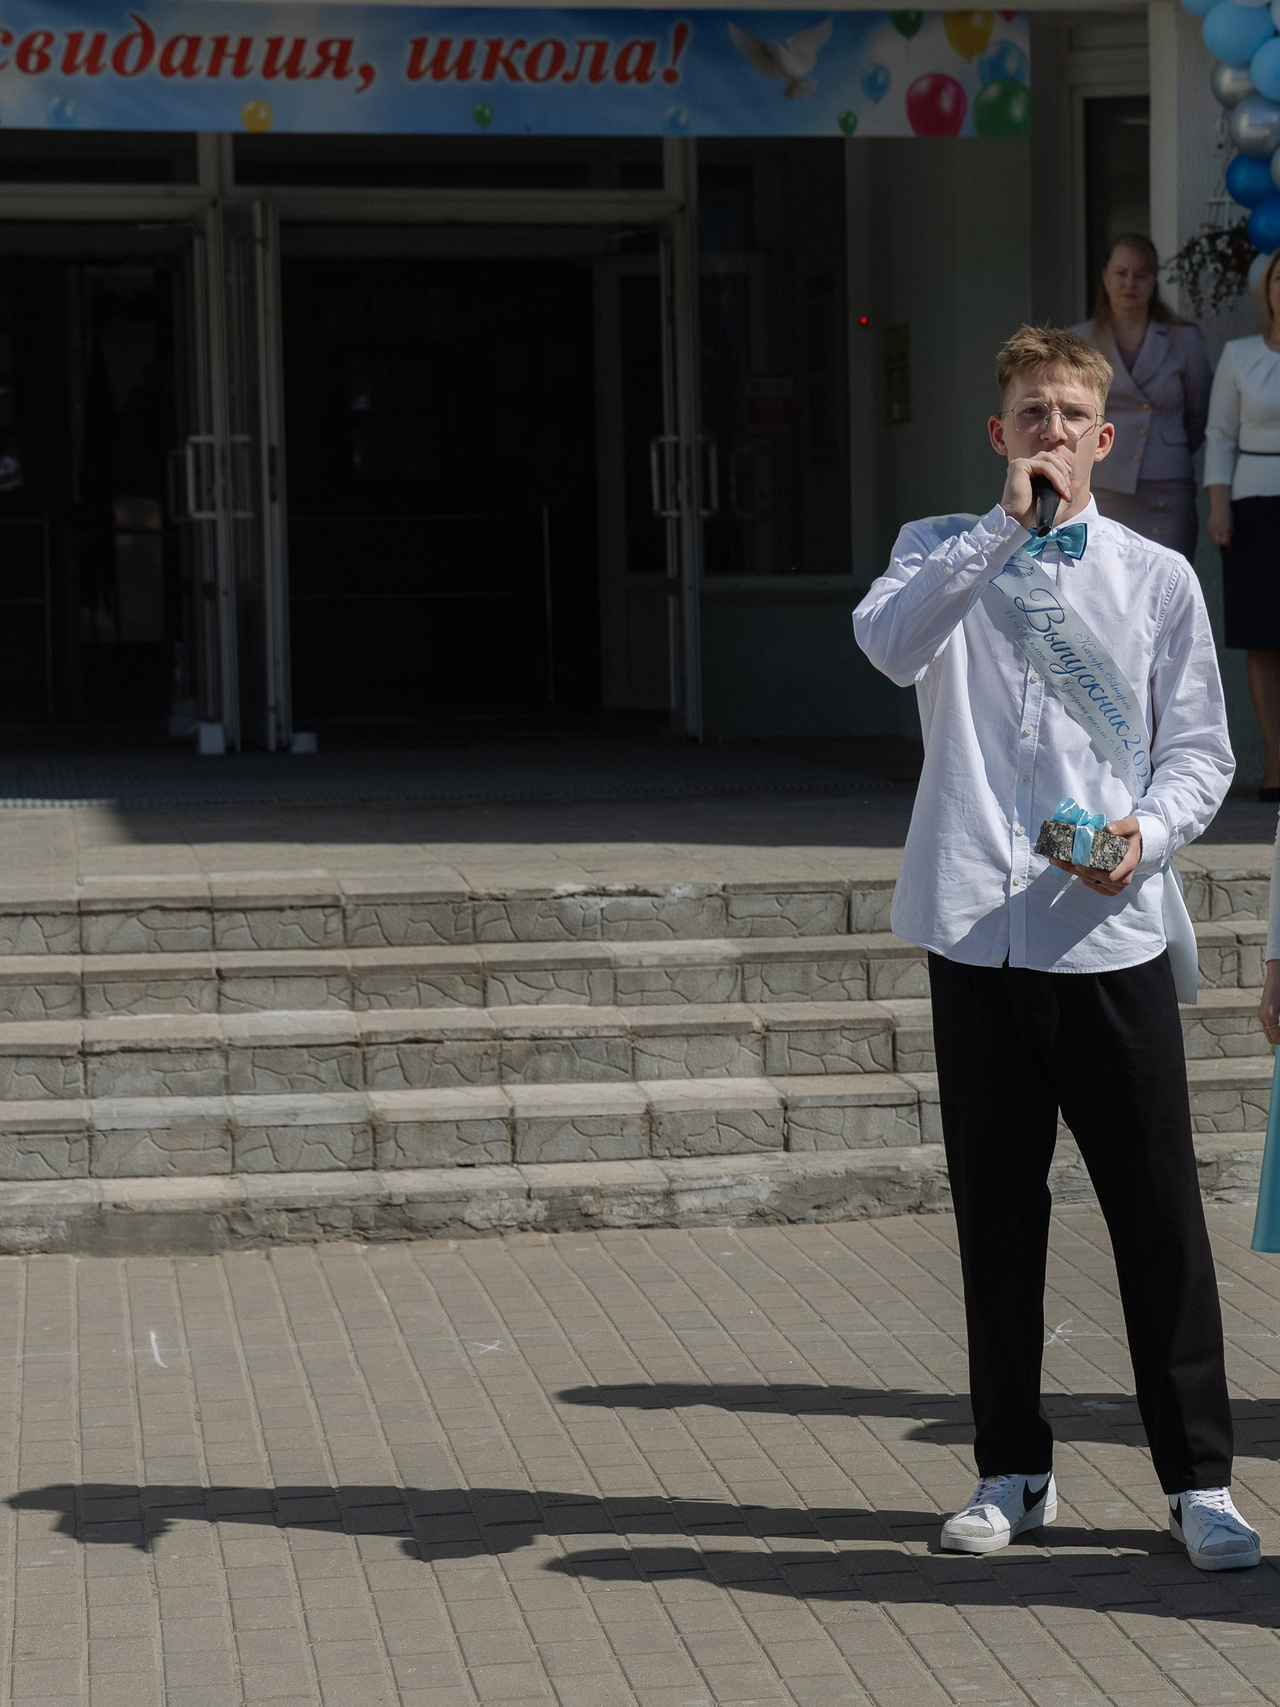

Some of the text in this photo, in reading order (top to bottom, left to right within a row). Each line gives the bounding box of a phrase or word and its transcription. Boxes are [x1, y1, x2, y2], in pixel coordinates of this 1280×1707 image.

[406, 22, 690, 85] школа!
[1104, 673, 1132, 711] Андрей
[1087, 715, 1108, 740] школа
